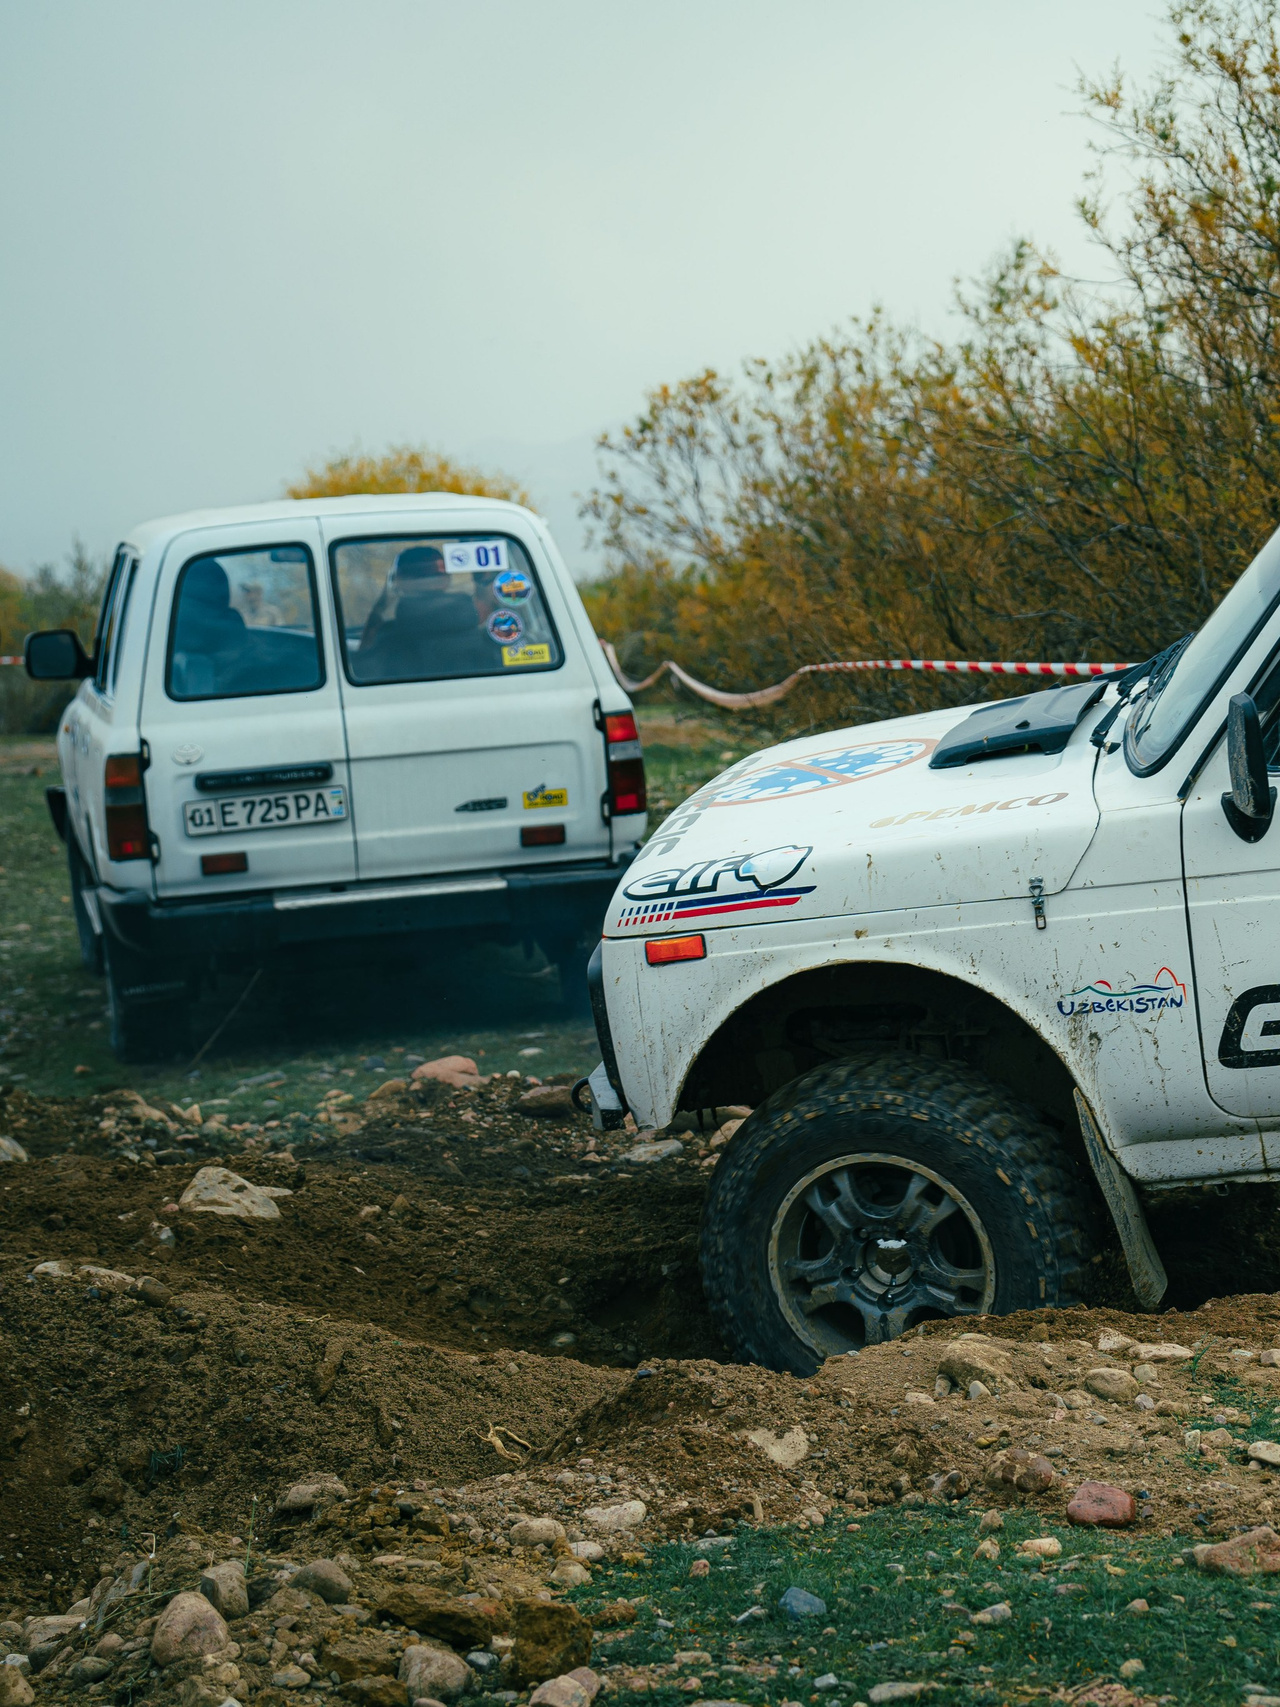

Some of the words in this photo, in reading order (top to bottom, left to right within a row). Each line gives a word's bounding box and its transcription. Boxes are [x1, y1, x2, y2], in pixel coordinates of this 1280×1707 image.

[476, 546, 501, 567] 01
[190, 808, 215, 827] 01
[893, 792, 1070, 826] PEMCO
